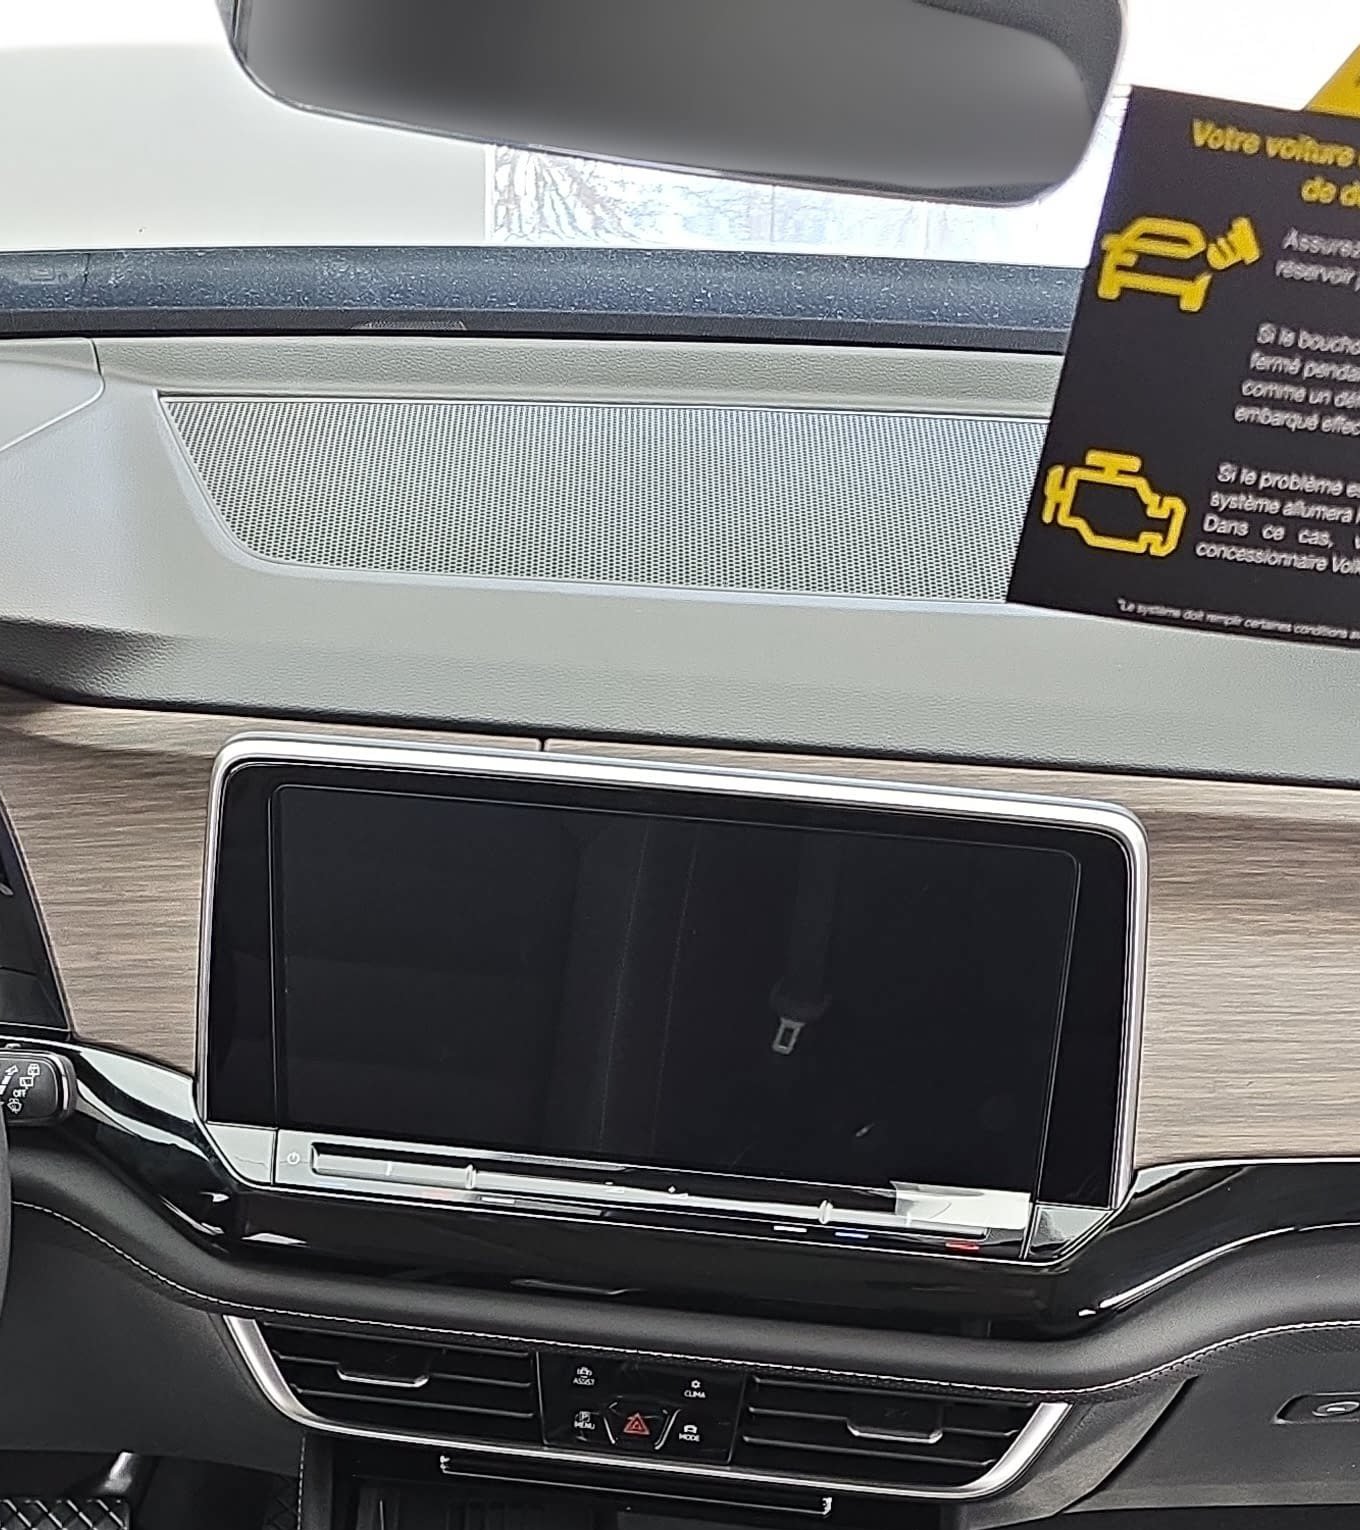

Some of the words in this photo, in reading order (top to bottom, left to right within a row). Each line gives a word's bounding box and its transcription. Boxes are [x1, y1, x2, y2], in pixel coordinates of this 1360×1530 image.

[1192, 119, 1261, 154] Votre
[1265, 135, 1354, 169] voiture
[1301, 177, 1336, 204] de
[1275, 260, 1356, 285] réservoir
[1257, 323, 1277, 344] Si
[1278, 326, 1296, 348] le
[1250, 350, 1302, 375] fermé
[1242, 379, 1307, 402] comme
[1309, 389, 1332, 404] un
[1234, 406, 1319, 432] embarqué
[1217, 462, 1238, 484] Si
[1240, 467, 1257, 485] le
[1259, 471, 1344, 496] problème
[1210, 491, 1280, 514] système
[1282, 501, 1353, 523] allumera
[1203, 513, 1249, 536] Dans
[1262, 524, 1285, 541] ce
[1298, 528, 1335, 548] cas,
[1196, 542, 1328, 572] concessionnaire
[684, 1391, 706, 1399] CLIMA
[574, 1421, 596, 1431] MENU
[679, 1433, 701, 1442] MODE
